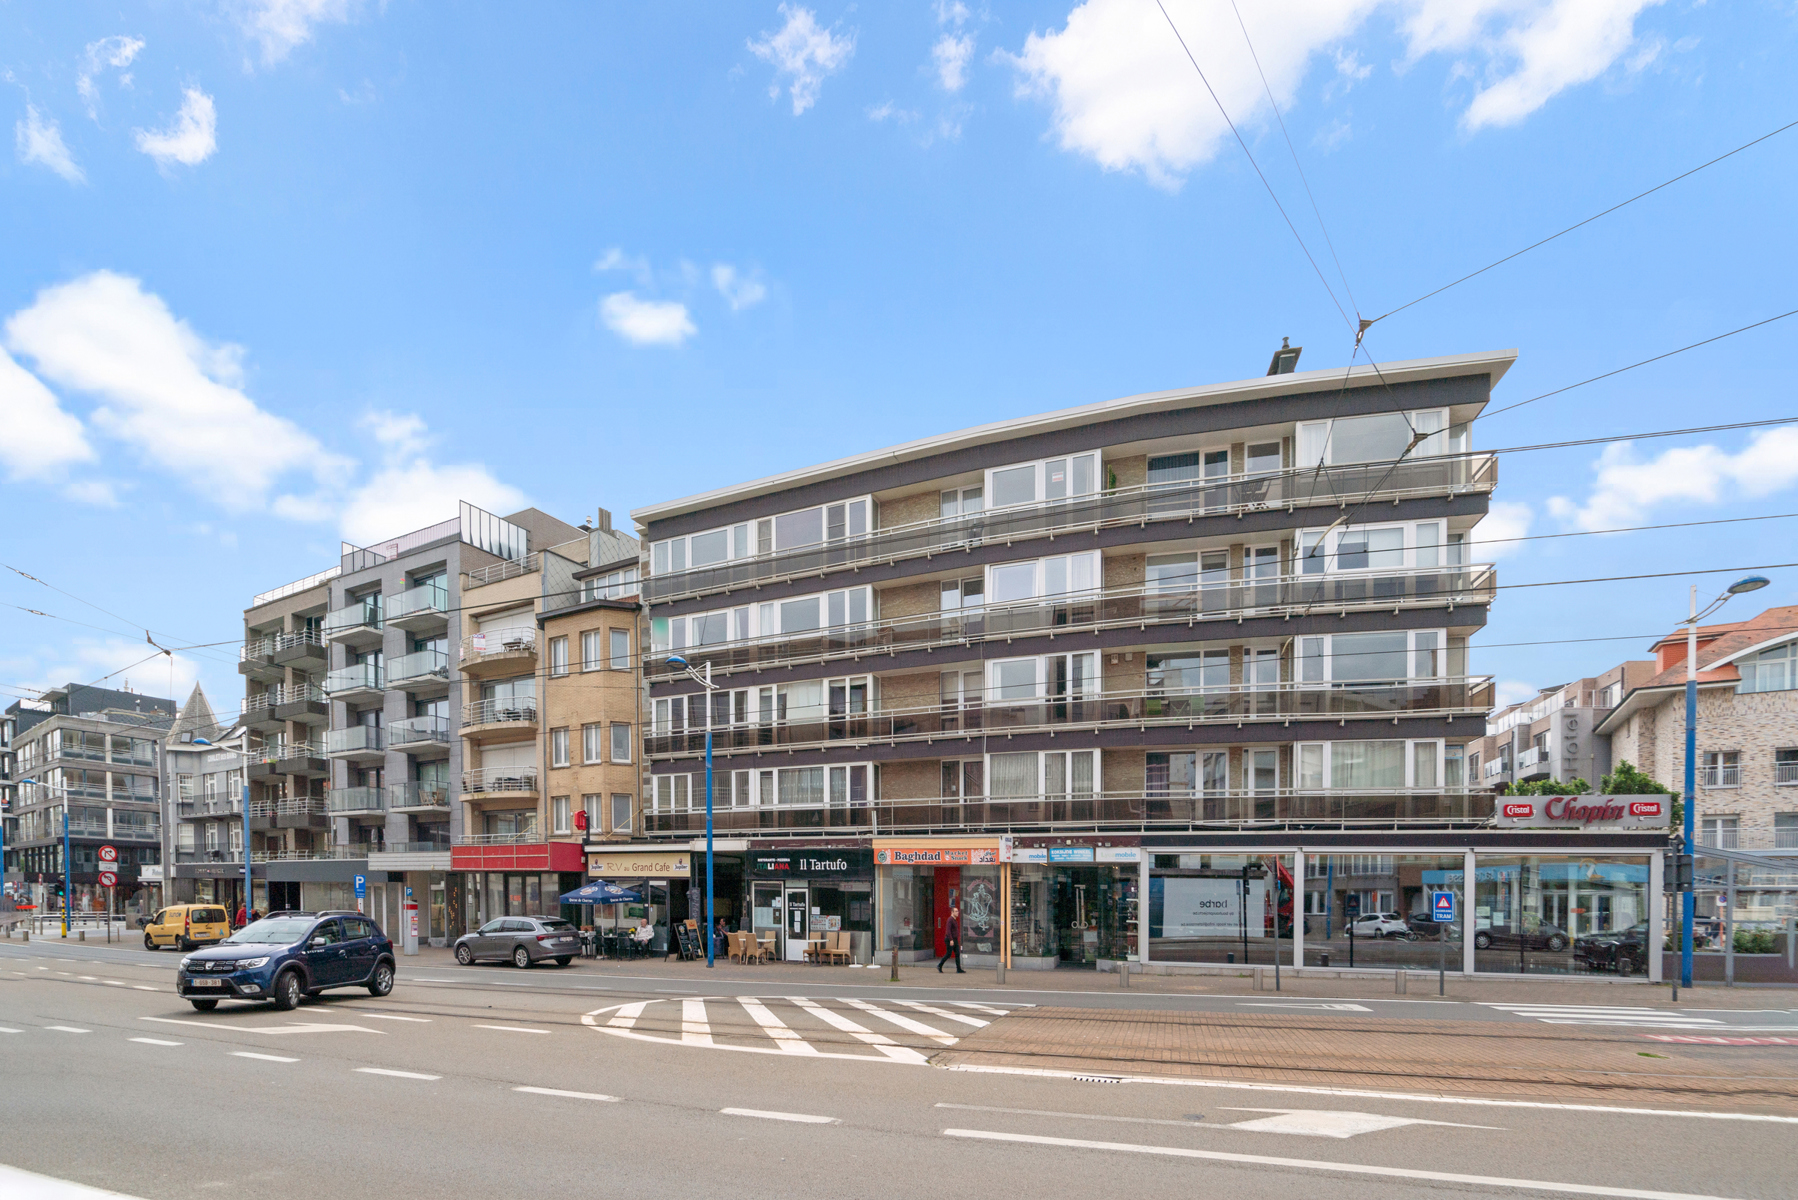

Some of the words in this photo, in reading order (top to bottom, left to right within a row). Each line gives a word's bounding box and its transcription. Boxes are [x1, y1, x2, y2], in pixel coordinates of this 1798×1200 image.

[1507, 805, 1530, 815] Cristal
[1545, 796, 1625, 824] Chopin
[1633, 803, 1657, 813] Cristal
[894, 851, 941, 862] Baghdad
[607, 862, 622, 871] RV
[632, 862, 653, 871] Grand
[800, 859, 807, 870] Il
[809, 859, 847, 870] Tartufo
[356, 876, 364, 888] P
